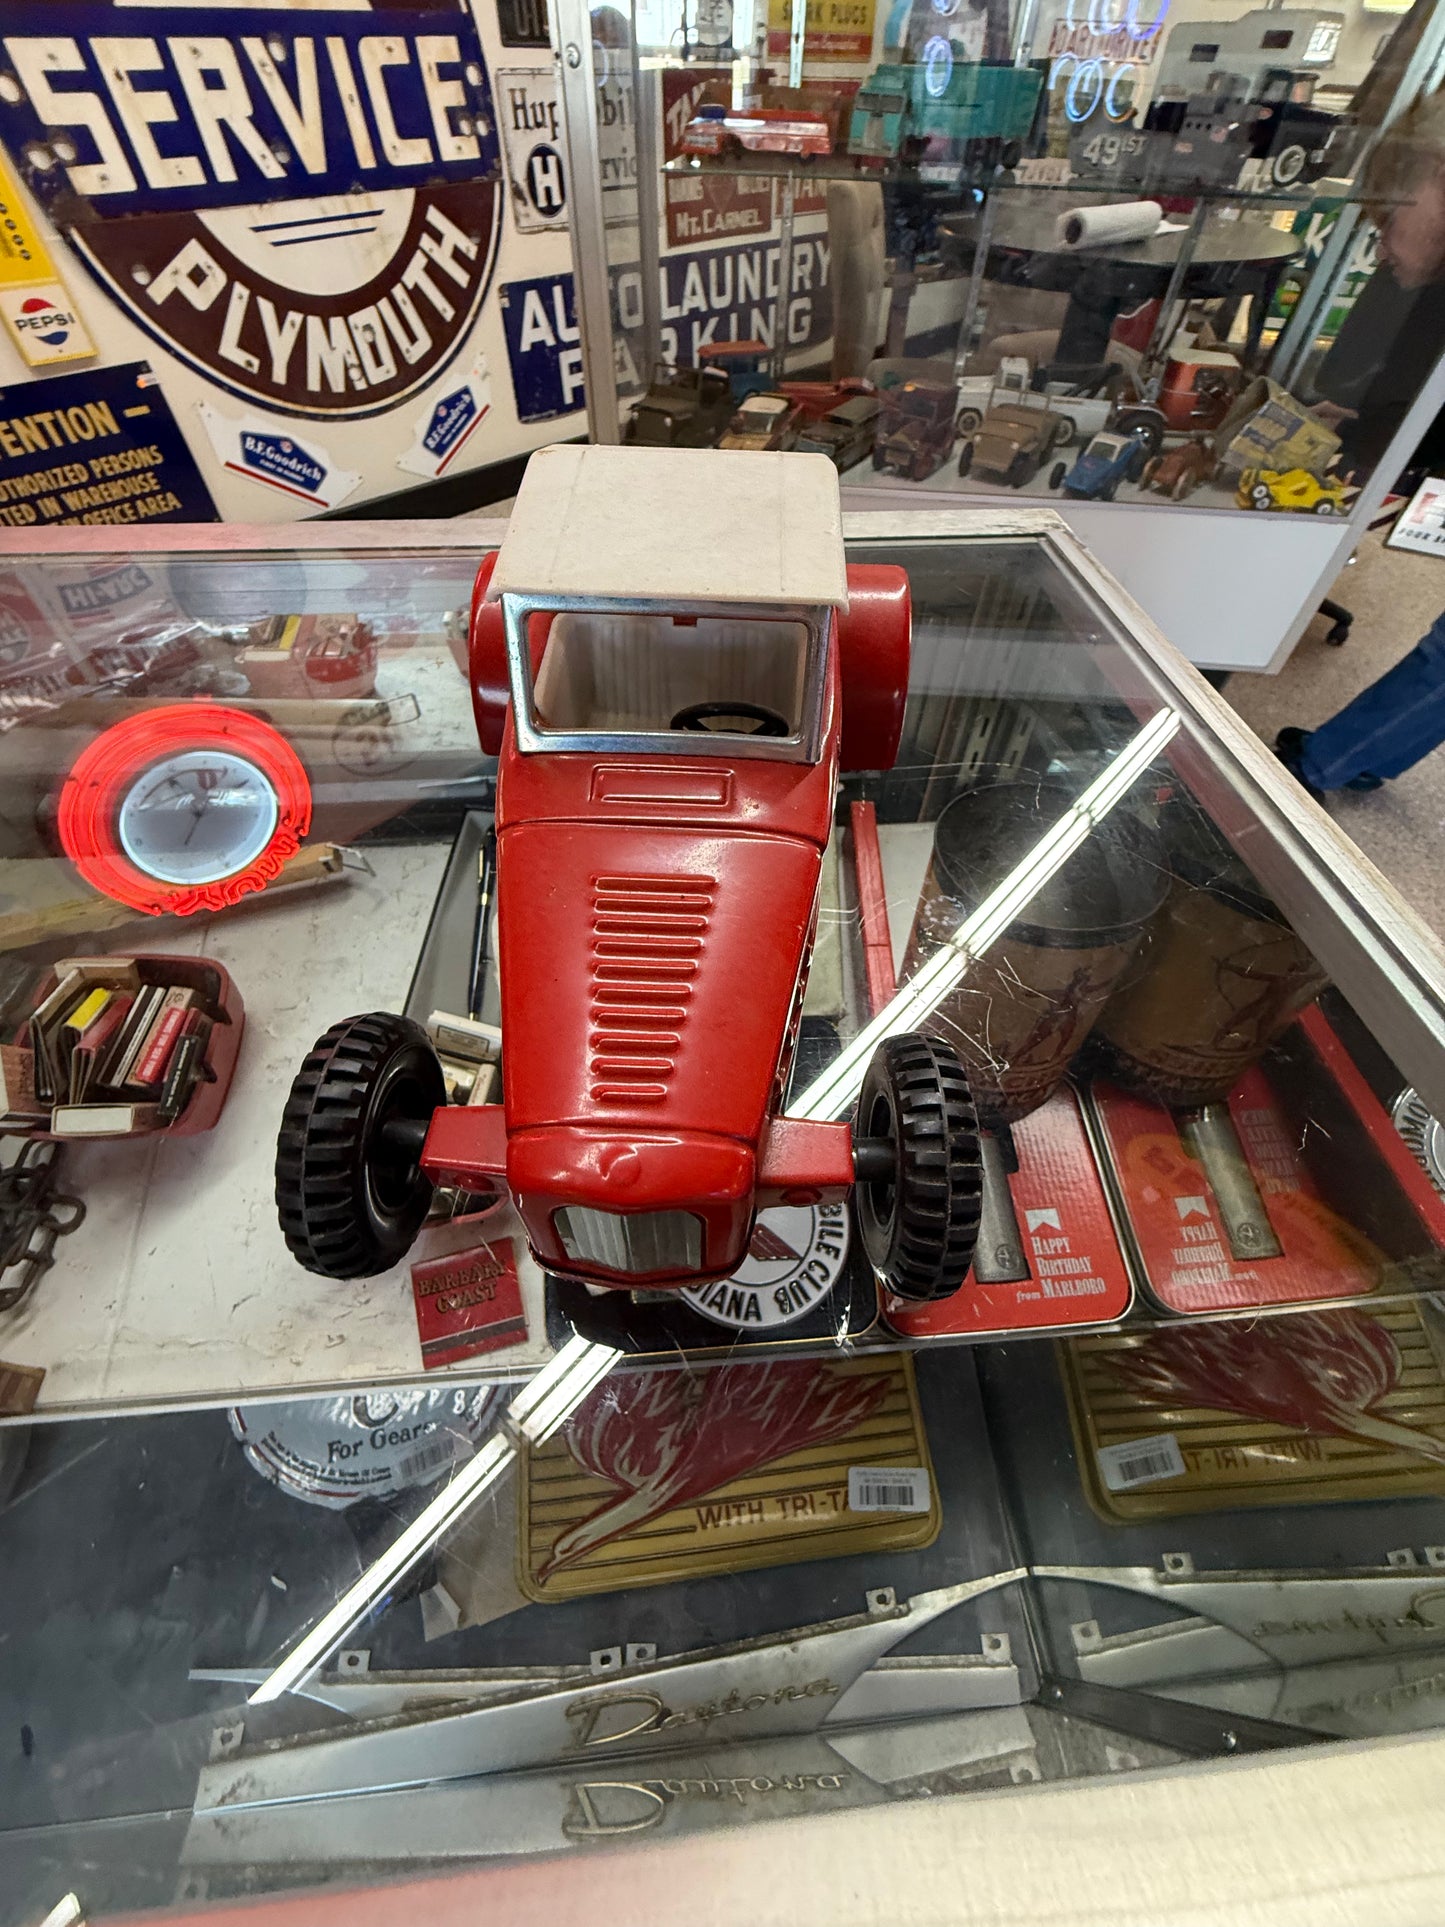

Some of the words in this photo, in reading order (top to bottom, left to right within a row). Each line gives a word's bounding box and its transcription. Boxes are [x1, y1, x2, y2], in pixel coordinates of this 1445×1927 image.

[3, 36, 482, 196] SERVICE
[532, 155, 562, 208] H
[659, 240, 833, 320] LAUNDRY
[146, 204, 478, 393] PLYMOUTH
[14, 311, 76, 332] PEPSI
[88, 445, 164, 479] PERSONS
[36, 496, 63, 518] IN
[61, 472, 161, 511] WAREHOUSE
[135, 492, 183, 518] AREA
[1031, 1236, 1071, 1256] HAPPY
[1035, 1256, 1092, 1277] BIRTHDAY
[436, 1282, 497, 1314] COAST
[773, 1259, 831, 1315] CLUB
[1016, 1290, 1041, 1304] from
[1040, 1277, 1107, 1298] MARLBORO
[327, 1439, 363, 1463] For
[696, 1500, 763, 1530] WITH
[564, 1677, 841, 1748] Daytona
